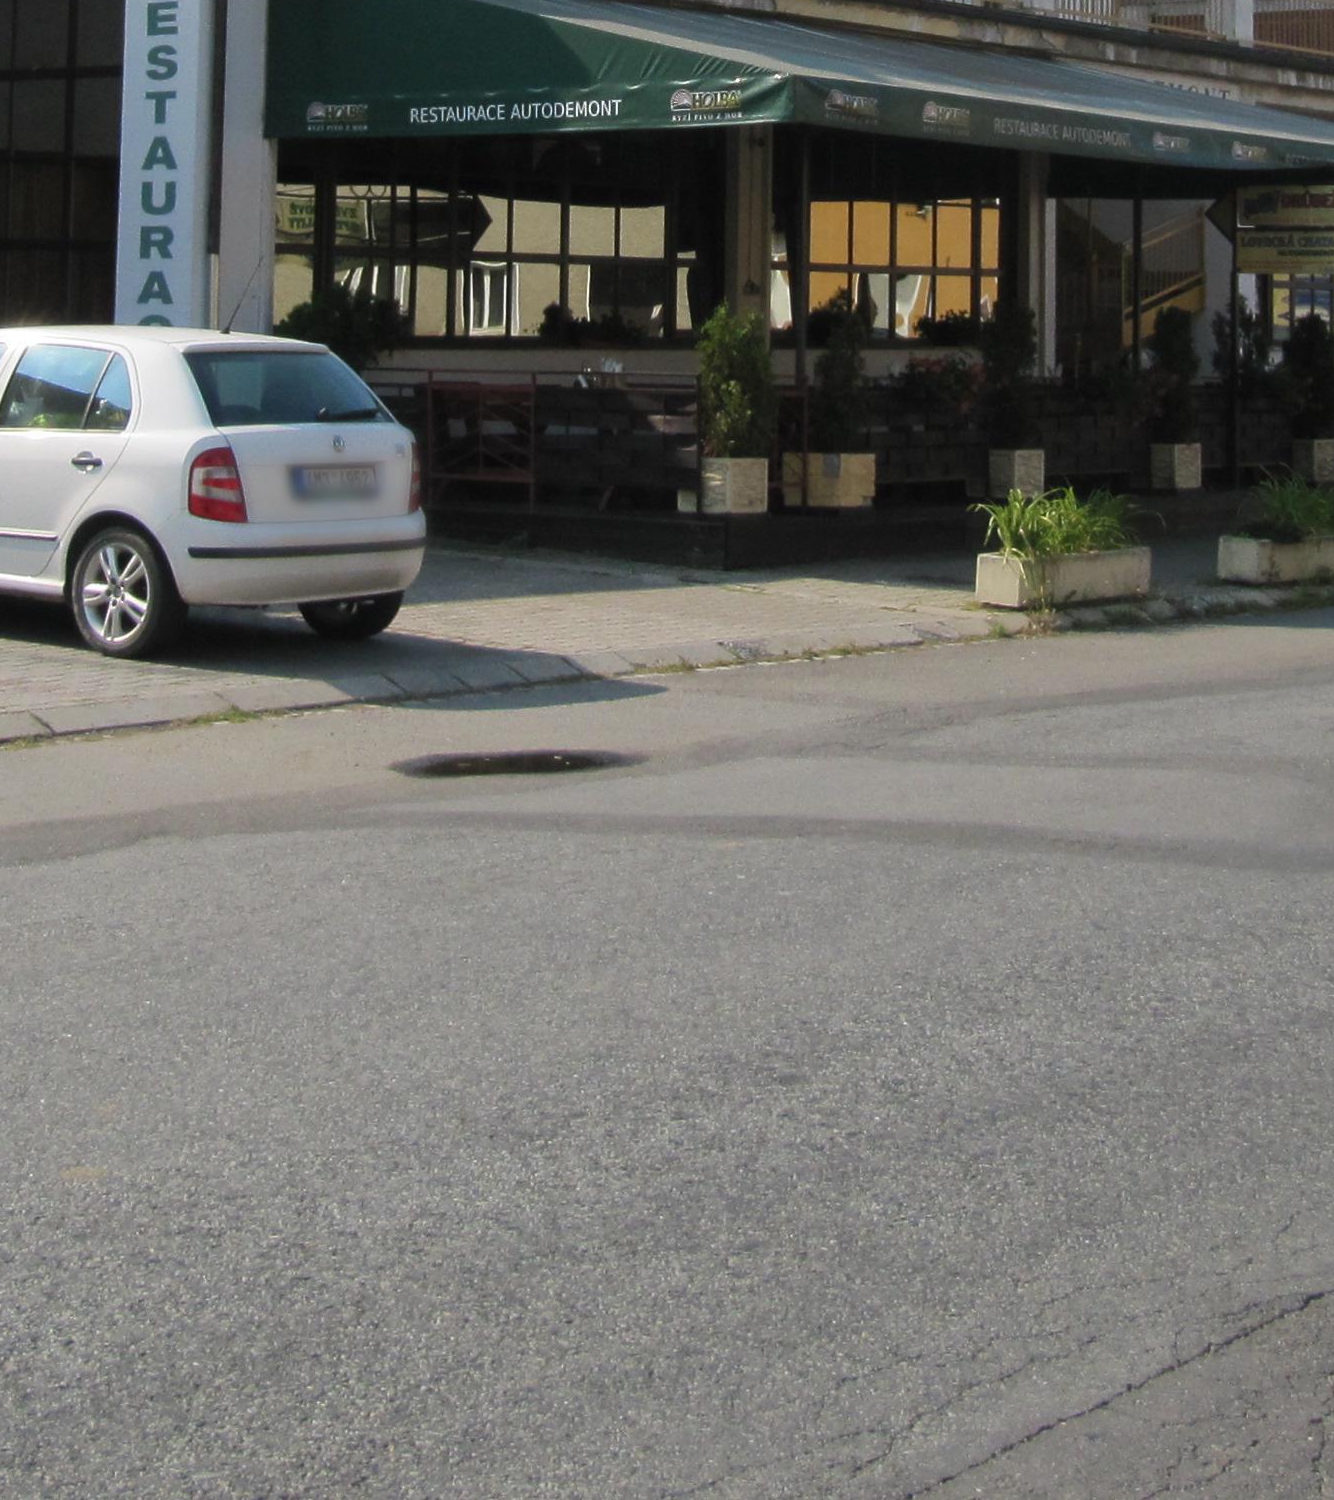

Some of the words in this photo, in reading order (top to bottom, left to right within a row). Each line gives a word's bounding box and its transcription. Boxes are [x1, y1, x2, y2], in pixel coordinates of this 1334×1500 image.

[409, 104, 506, 124] RESTAURACE
[510, 99, 622, 120] AUTODEMONT
[693, 90, 740, 109] HOLBA
[993, 117, 1059, 140] RESTAURACE
[1062, 125, 1131, 148] AUTODEMONT
